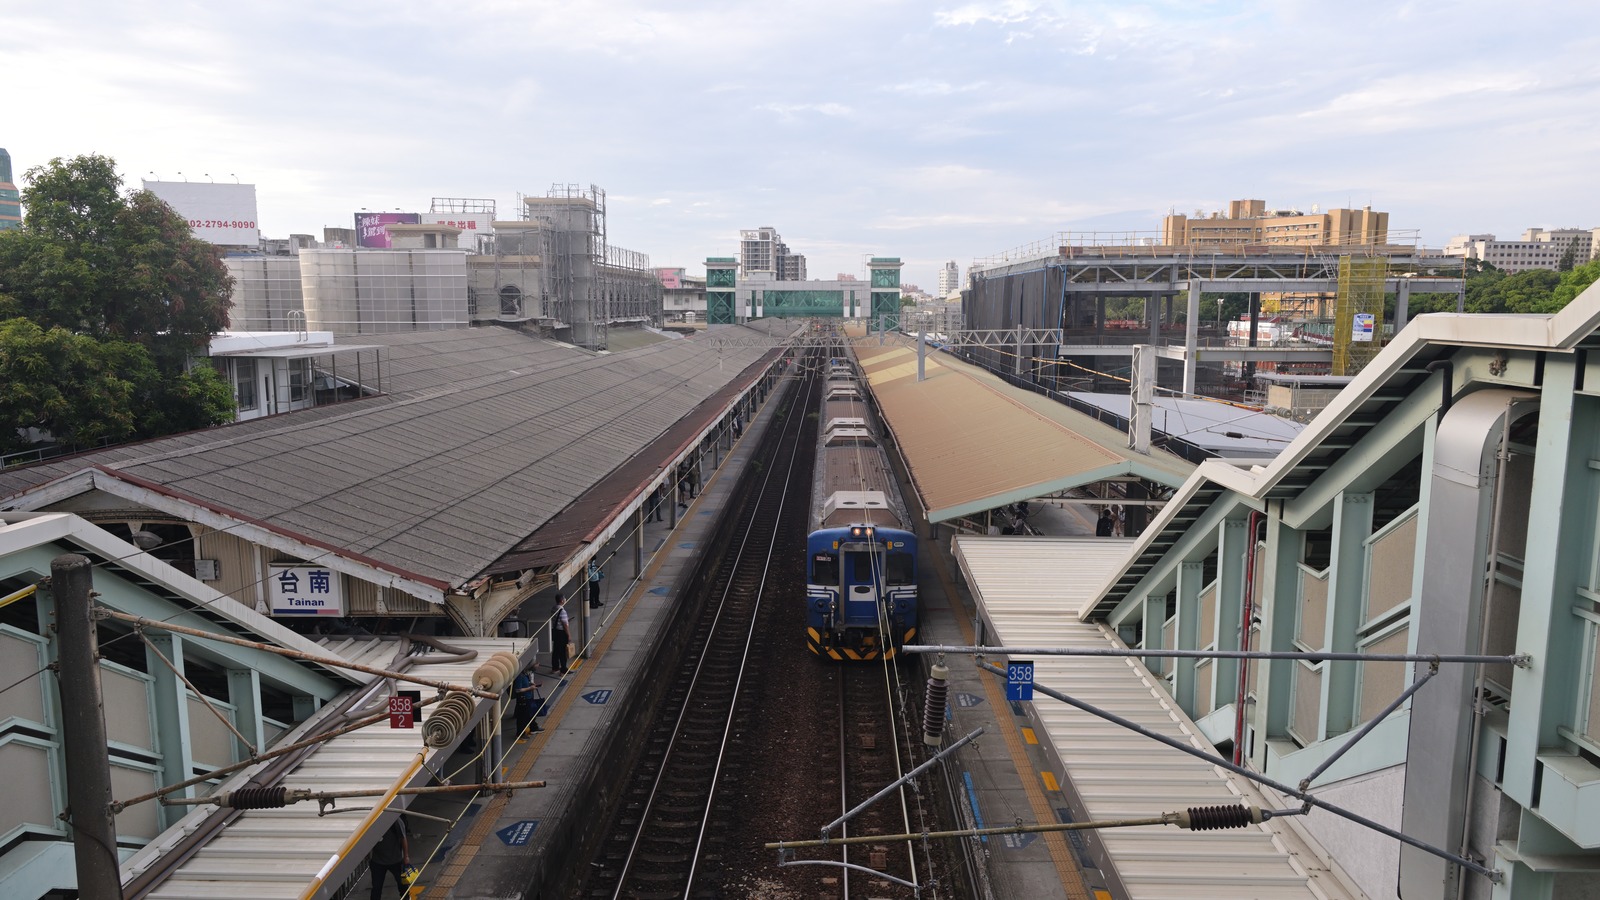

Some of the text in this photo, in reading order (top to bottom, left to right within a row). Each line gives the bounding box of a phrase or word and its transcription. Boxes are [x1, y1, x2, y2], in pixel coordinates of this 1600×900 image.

[190, 220, 255, 229] 02-2794-9090
[278, 569, 330, 594] 台南
[288, 598, 324, 606] Tainan
[1009, 666, 1032, 680] 358
[1016, 685, 1022, 699] 1
[390, 698, 411, 711] 358
[398, 715, 405, 727] 2
